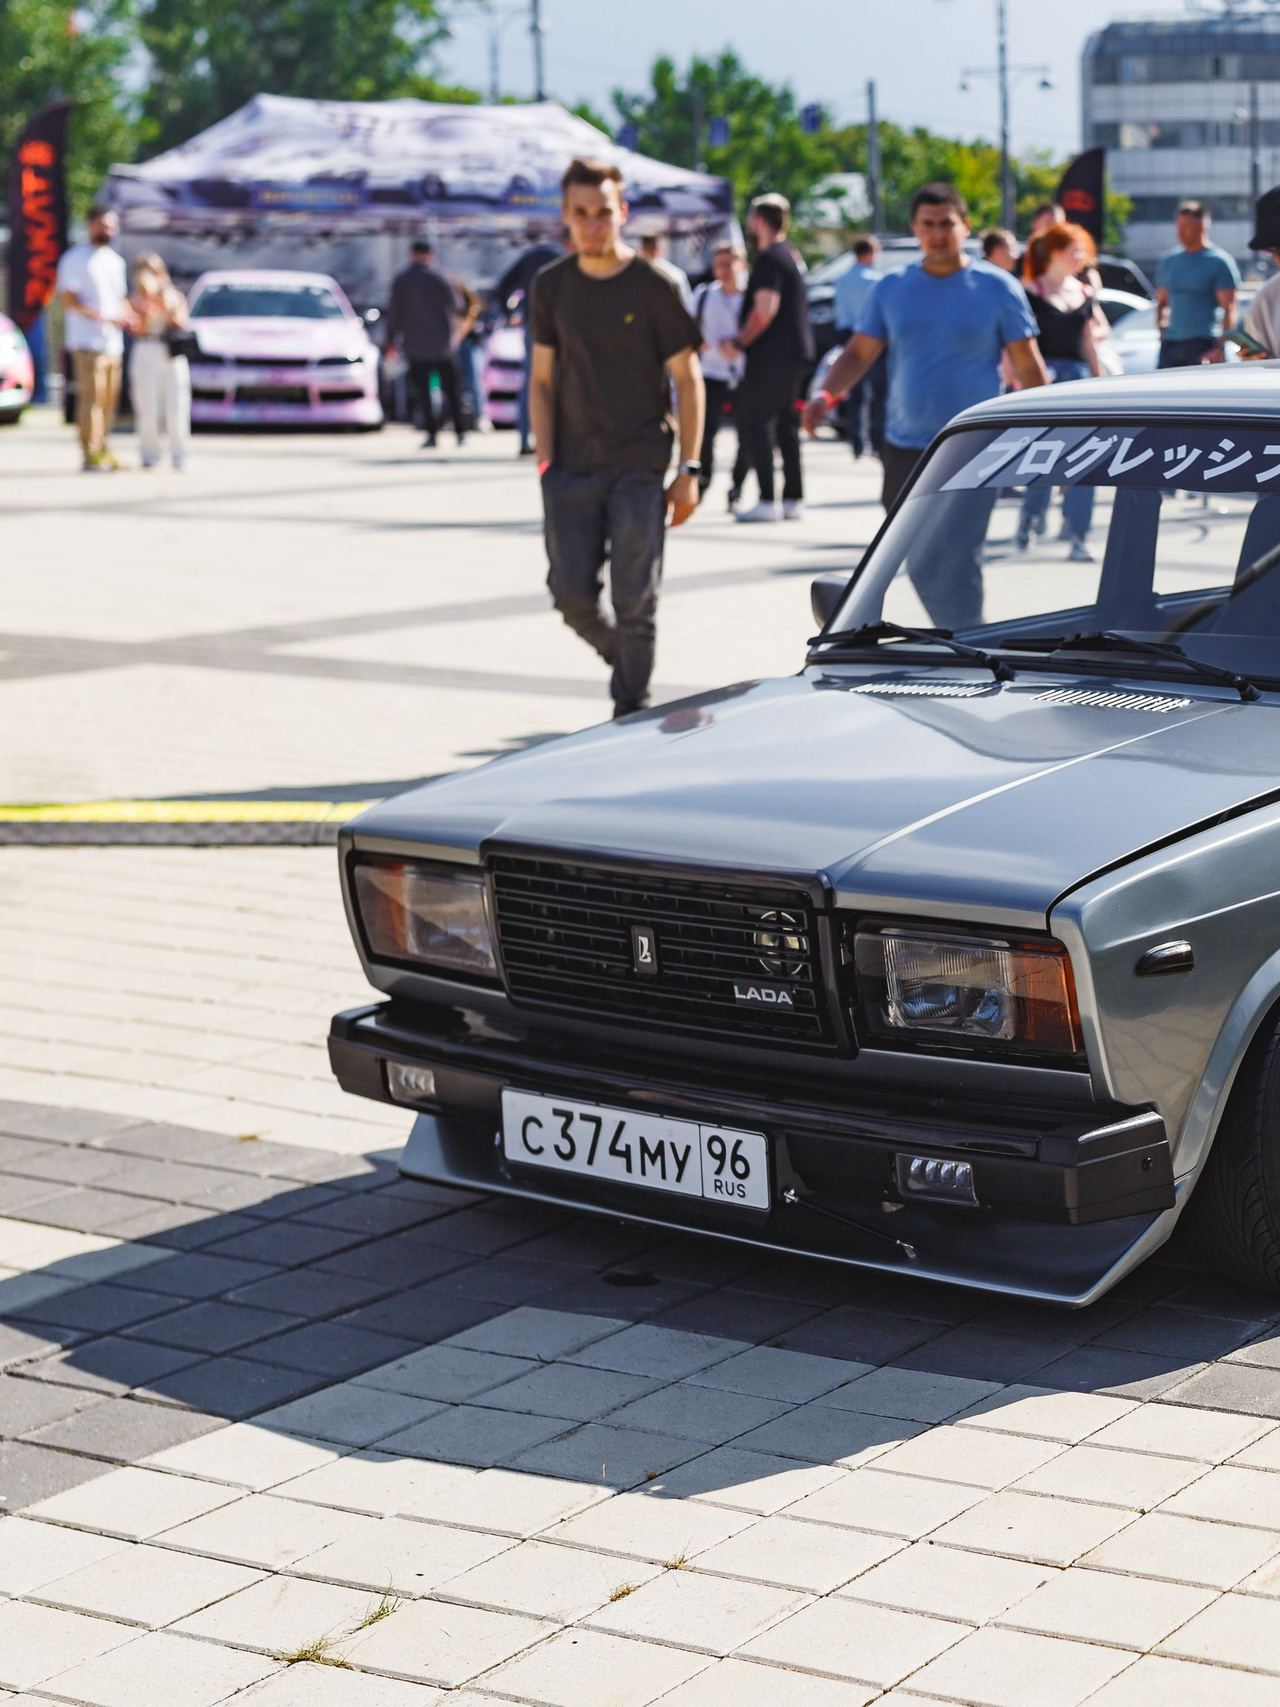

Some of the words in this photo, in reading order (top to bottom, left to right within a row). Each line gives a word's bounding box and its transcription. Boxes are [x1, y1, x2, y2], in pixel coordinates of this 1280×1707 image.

[734, 985, 793, 1005] LADA
[707, 1135, 750, 1180] 96
[714, 1179, 746, 1198] RUS
